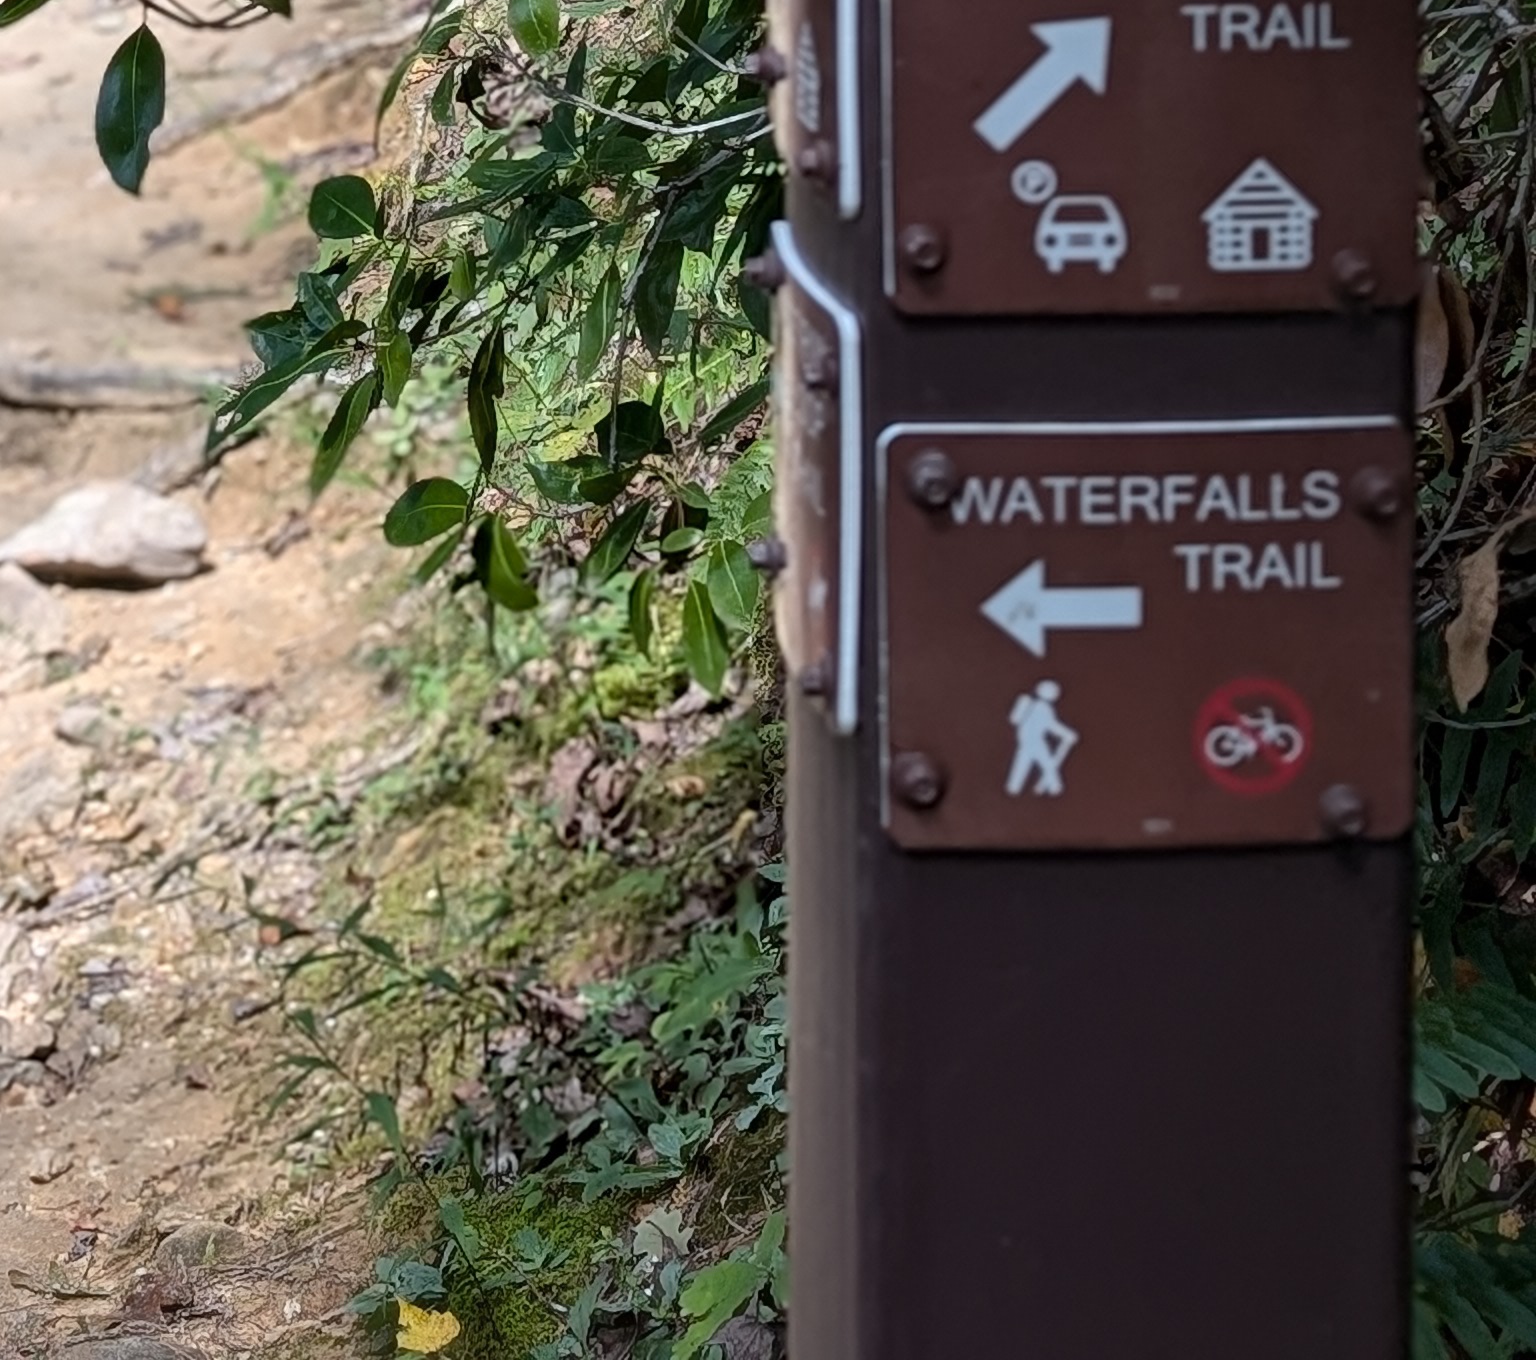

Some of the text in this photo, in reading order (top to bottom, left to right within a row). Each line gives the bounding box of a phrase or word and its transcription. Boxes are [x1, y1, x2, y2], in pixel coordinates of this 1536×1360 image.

[1180, 2, 1351, 51] TRAIL
[951, 470, 1341, 524] WATERFALLS
[1173, 541, 1341, 591] TRAIL
